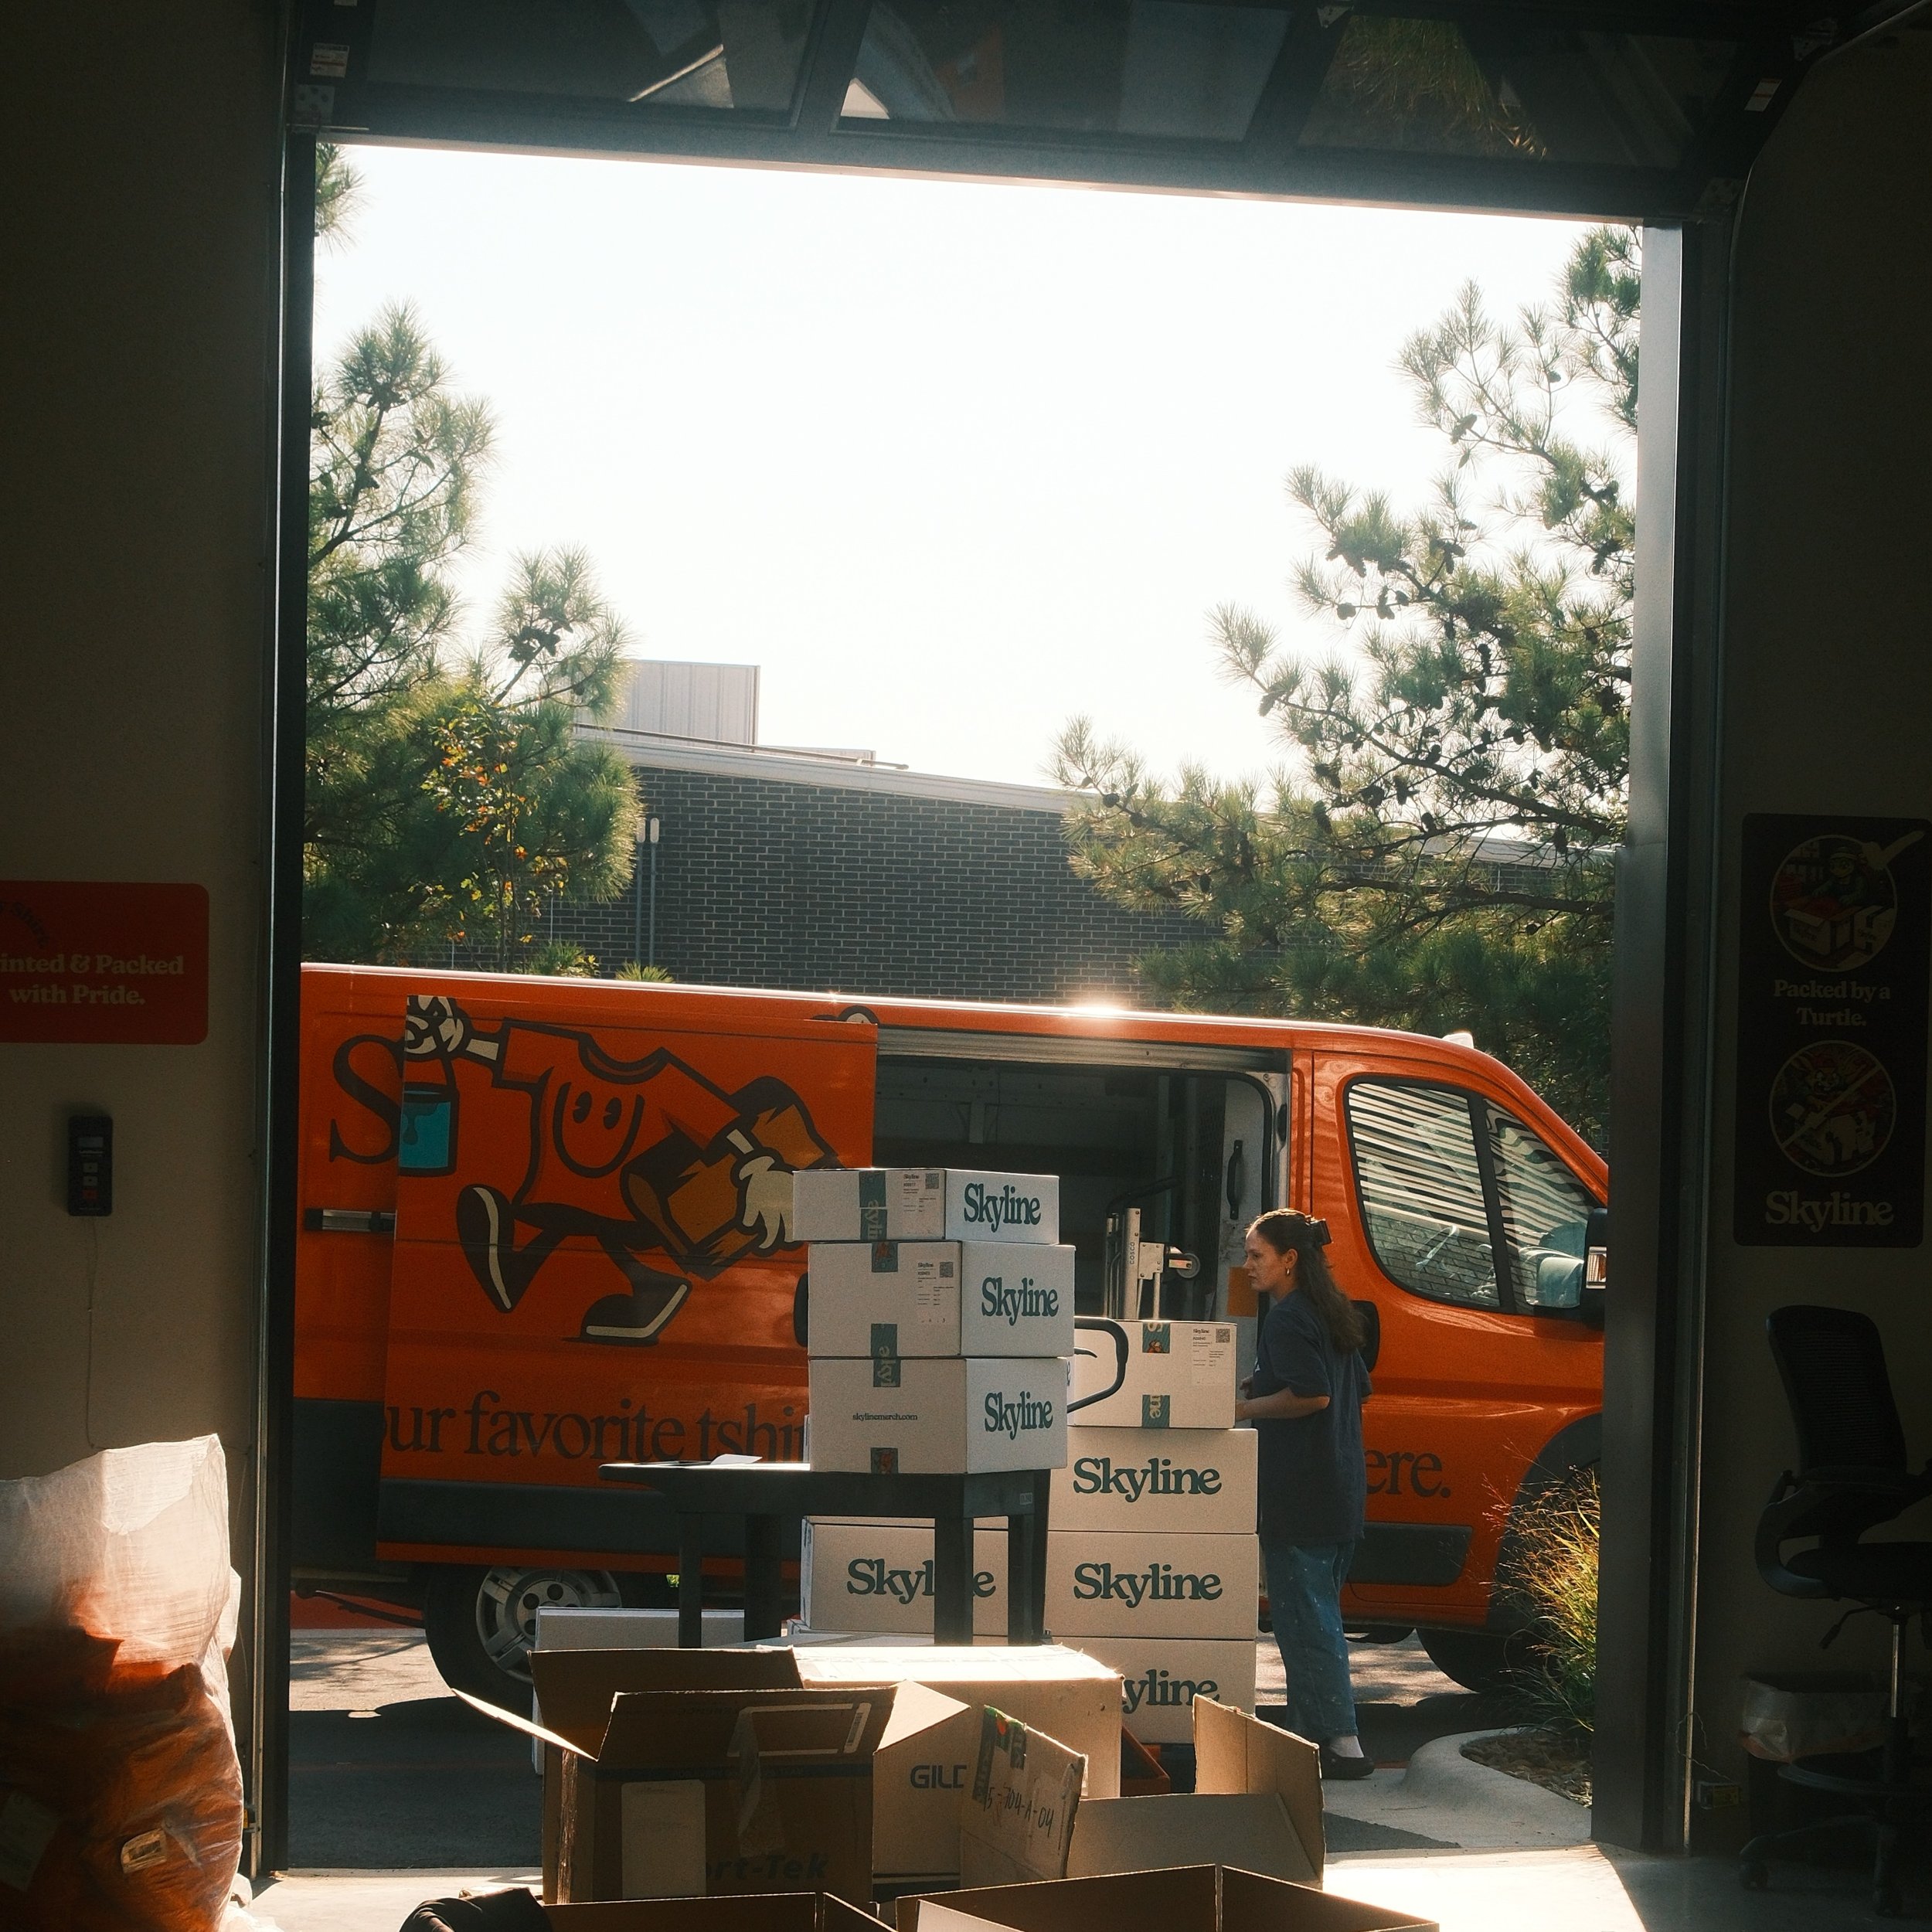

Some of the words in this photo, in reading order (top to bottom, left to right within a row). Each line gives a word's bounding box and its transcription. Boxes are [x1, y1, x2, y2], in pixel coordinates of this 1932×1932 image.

[0, 953, 65, 974] inted
[70, 954, 91, 974] &
[95, 954, 185, 975] Packed
[9, 983, 67, 1004] with
[72, 984, 147, 1005] Pride.
[1774, 978, 1848, 999] Packed
[1850, 980, 1877, 1004] by
[1879, 986, 1892, 1000] a
[1796, 1007, 1868, 1027] Turtle.
[963, 1182, 1042, 1233] Skyline
[1764, 1189, 1895, 1233] Skyline
[981, 1277, 1060, 1327] Skyline
[385, 1403, 457, 1454] ur
[464, 1389, 686, 1463] favorite
[698, 1402, 804, 1462] tshi
[852, 1412, 919, 1422] skylinemerch.com
[983, 1390, 1054, 1440] Skyline
[1073, 1458, 1223, 1502] Skyline
[846, 1557, 996, 1604] Skyle
[1073, 1563, 1223, 1608] Skyline
[1121, 1668, 1220, 1714] yline
